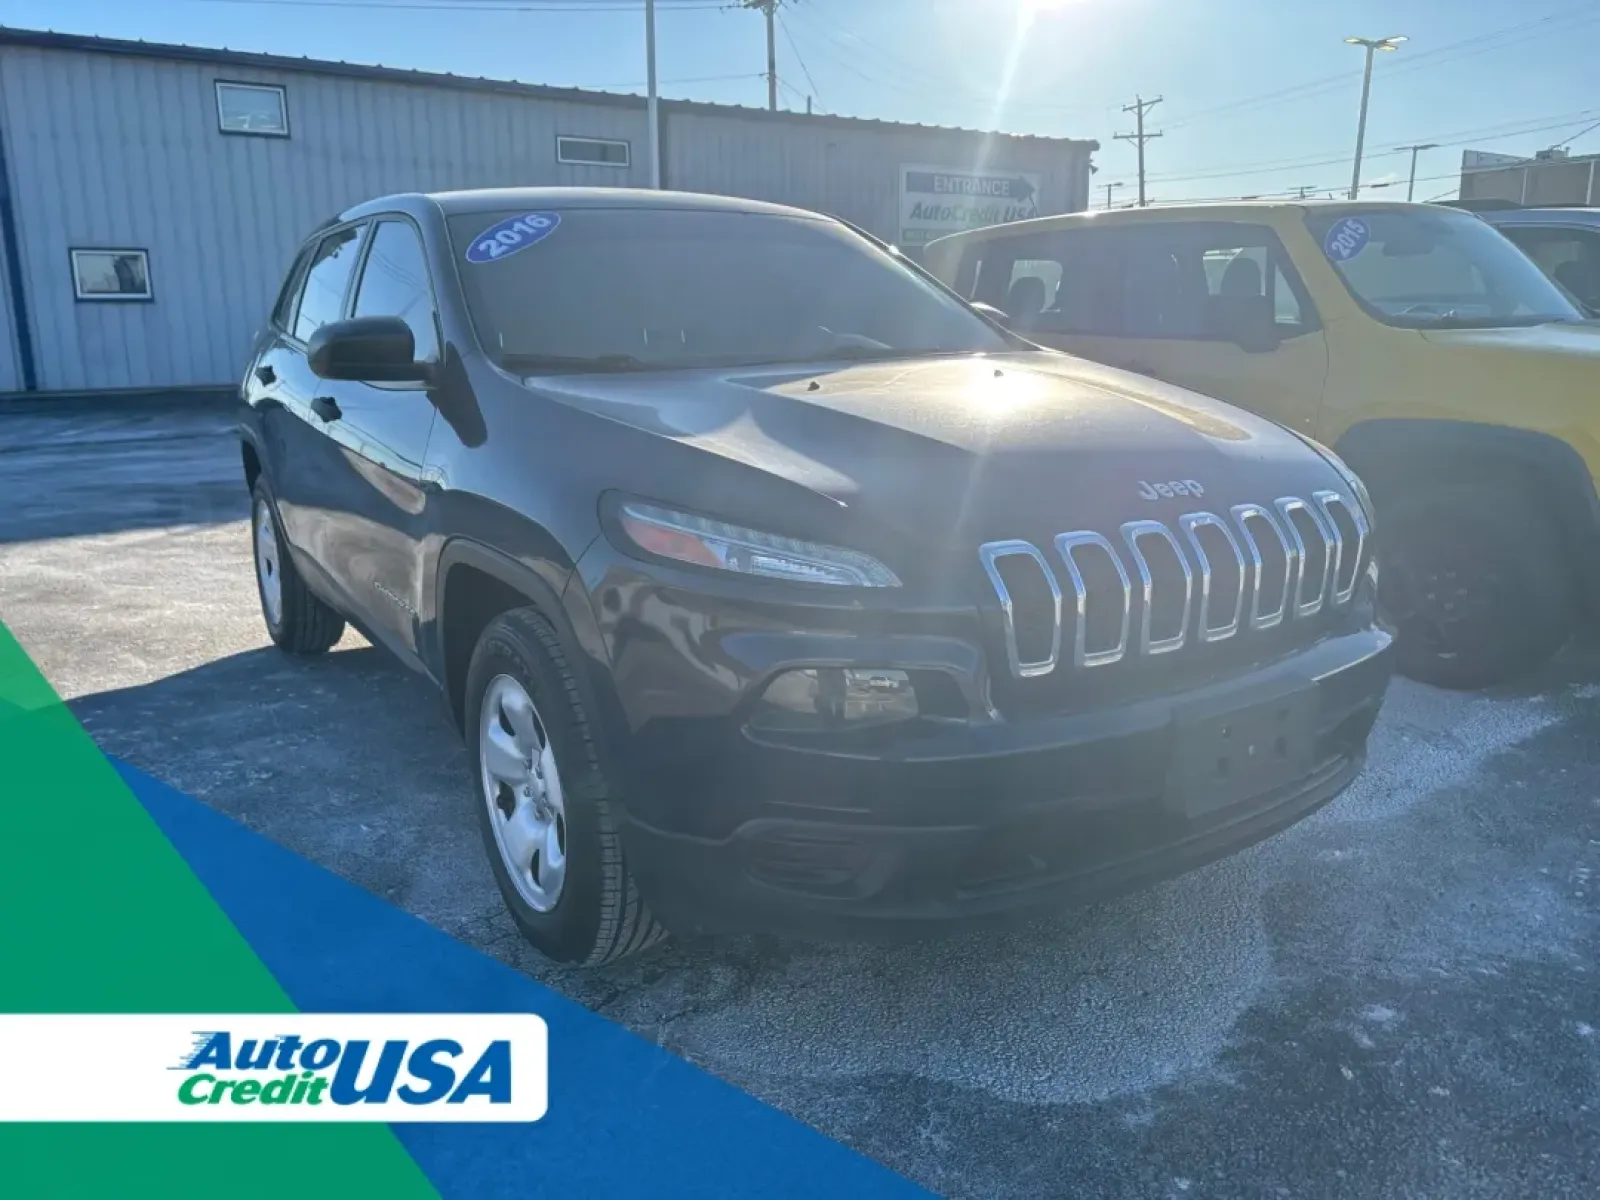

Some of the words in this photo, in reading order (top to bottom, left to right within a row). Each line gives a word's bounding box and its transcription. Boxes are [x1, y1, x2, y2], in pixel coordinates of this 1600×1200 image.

[933, 175, 1010, 196] ENTRANCE
[1003, 204, 1037, 222] USA
[477, 214, 552, 258] 2016
[1331, 218, 1366, 259] 2015
[1137, 479, 1204, 500] Jeep
